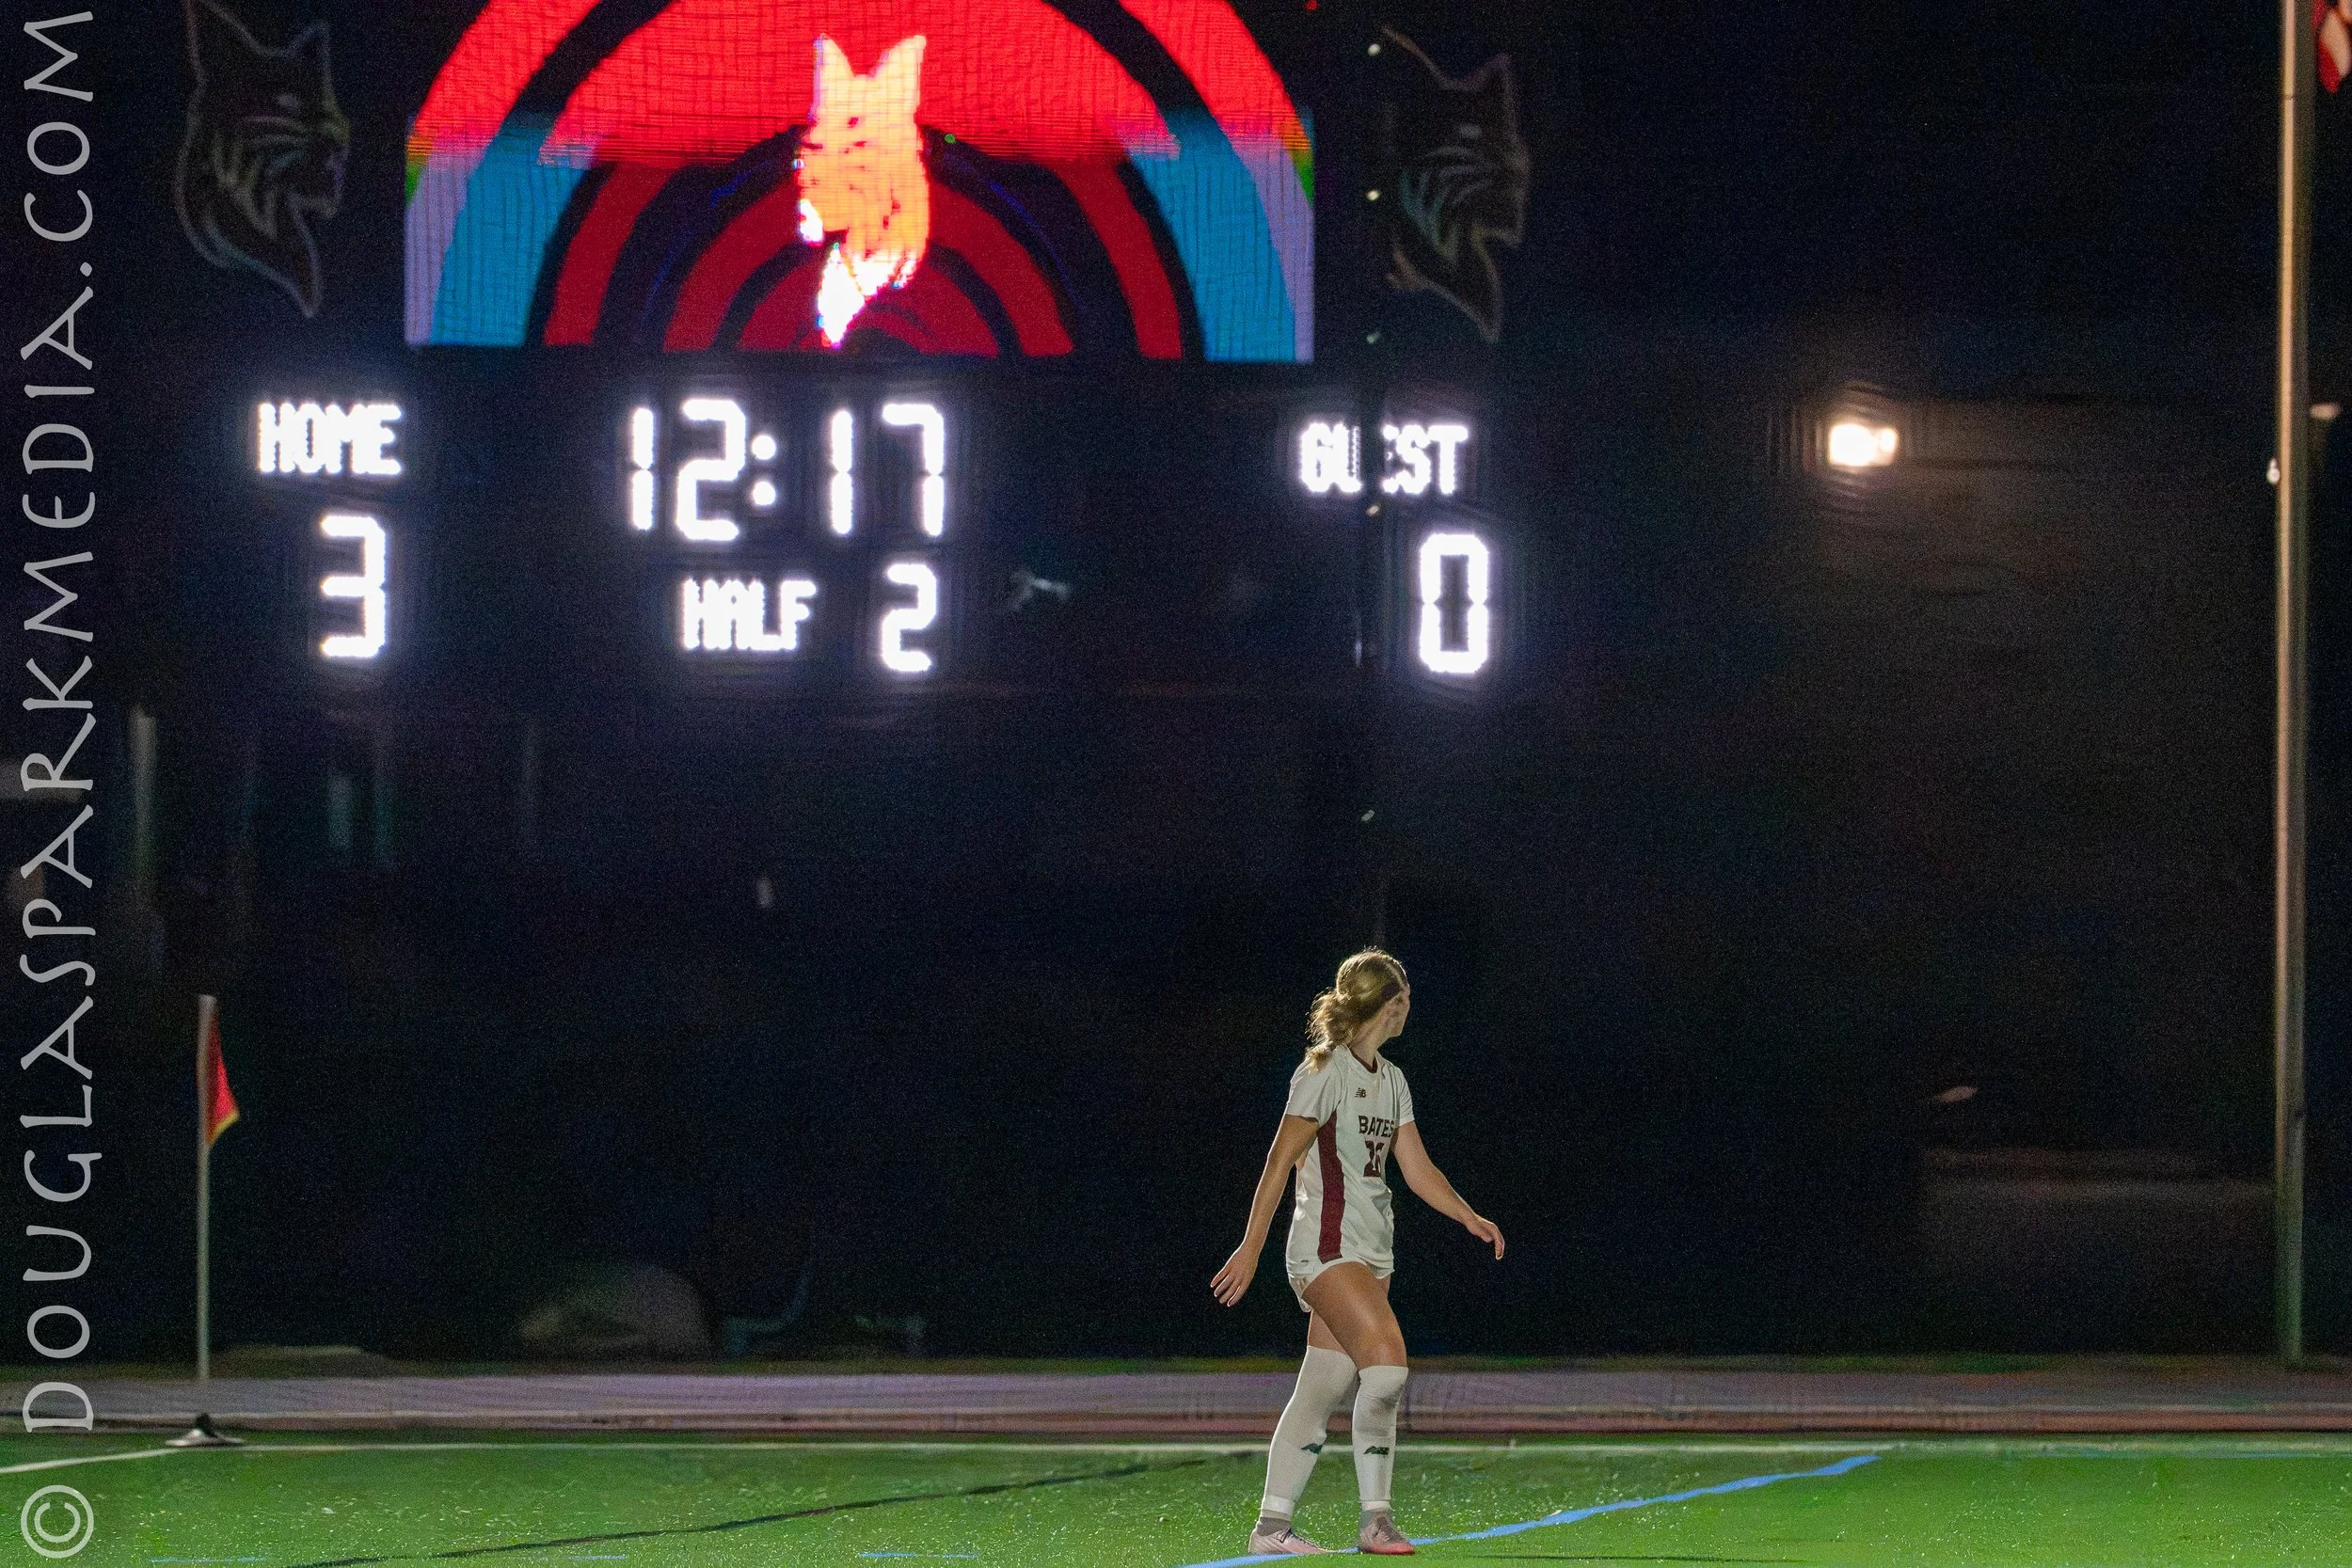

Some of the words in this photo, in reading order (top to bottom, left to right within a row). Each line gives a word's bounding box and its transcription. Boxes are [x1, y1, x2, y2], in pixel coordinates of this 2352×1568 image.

[258, 402, 403, 476] HOME
[630, 397, 946, 542] 12:17
[321, 515, 387, 658] 3
[682, 578, 817, 652] HALF
[880, 562, 938, 673] 2
[1419, 531, 1490, 674] 0
